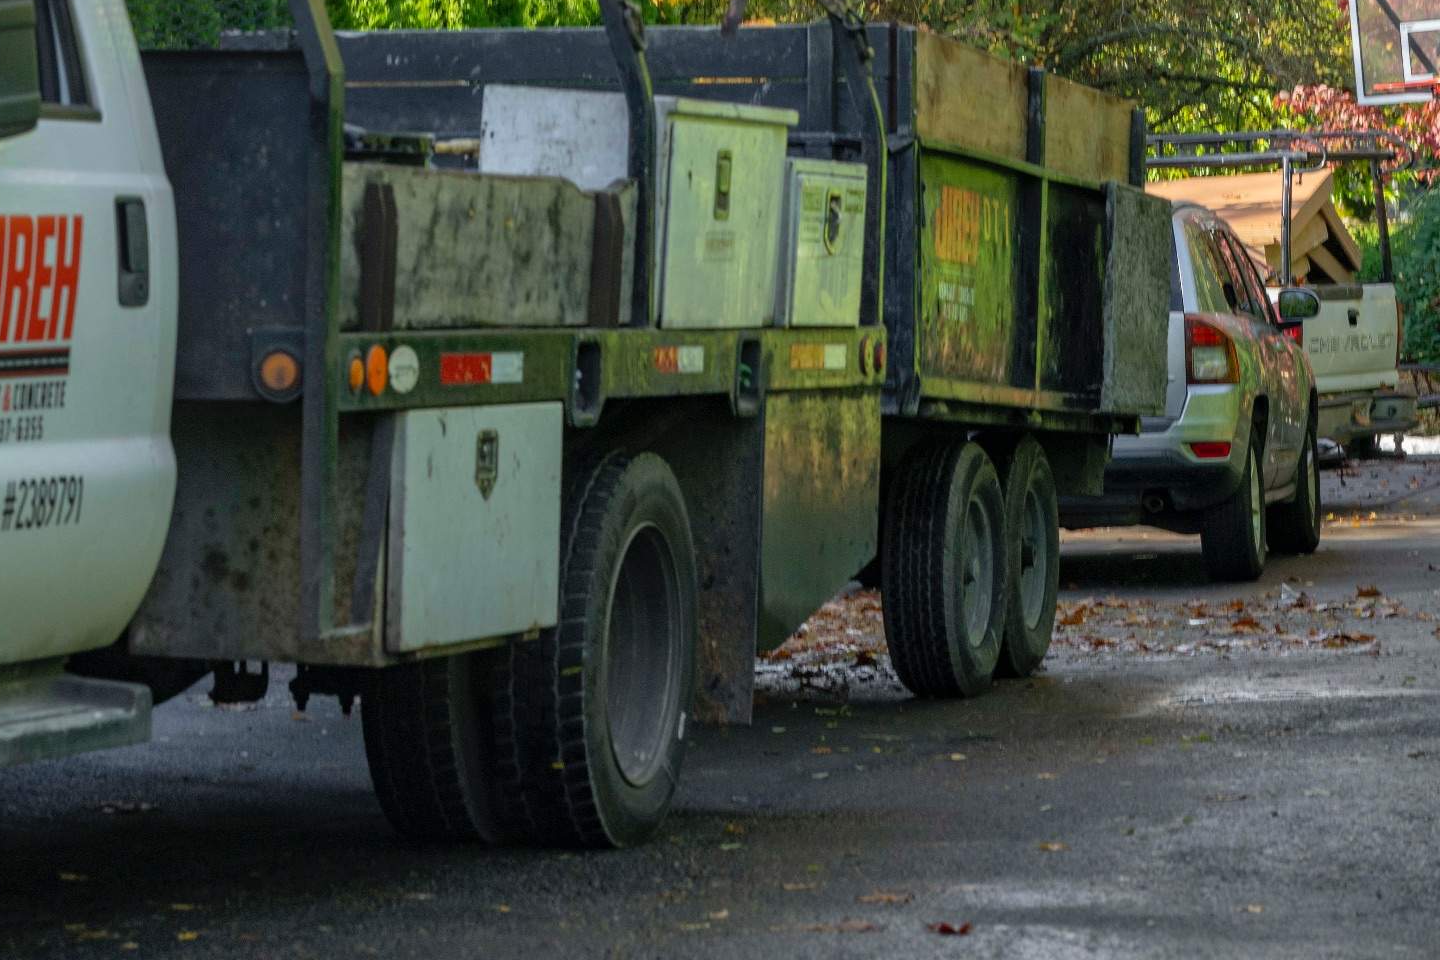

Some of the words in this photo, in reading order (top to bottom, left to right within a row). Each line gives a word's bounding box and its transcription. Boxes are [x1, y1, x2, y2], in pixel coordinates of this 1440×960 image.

[2, 383, 12, 413] &
[12, 380, 67, 411] CONCRETE
[0, 474, 84, 532] #2389791
